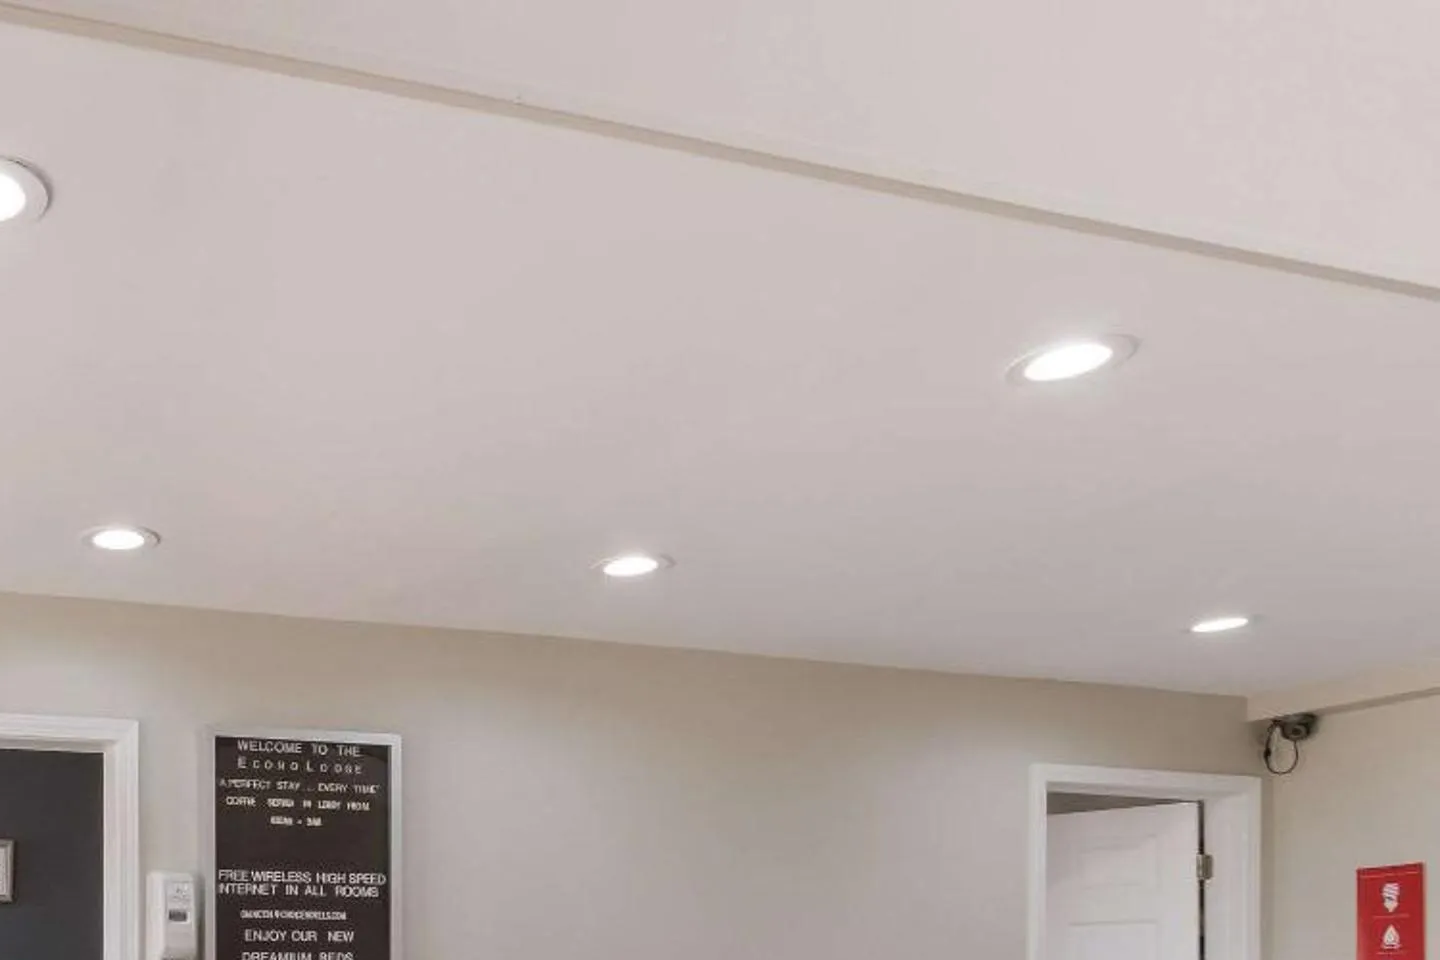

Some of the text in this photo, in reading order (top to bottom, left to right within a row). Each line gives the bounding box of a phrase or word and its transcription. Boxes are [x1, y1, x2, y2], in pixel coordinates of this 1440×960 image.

[237, 740, 361, 757] WELCOME TO THE
[275, 780, 301, 790] STAY
[318, 782, 348, 793] EVERY
[218, 869, 386, 886] FREE WIRELESS HIGH SPEED
[219, 883, 379, 898] INTERNET IN ALL ROOMS
[244, 929, 354, 942] ENJOY OUR NEW
